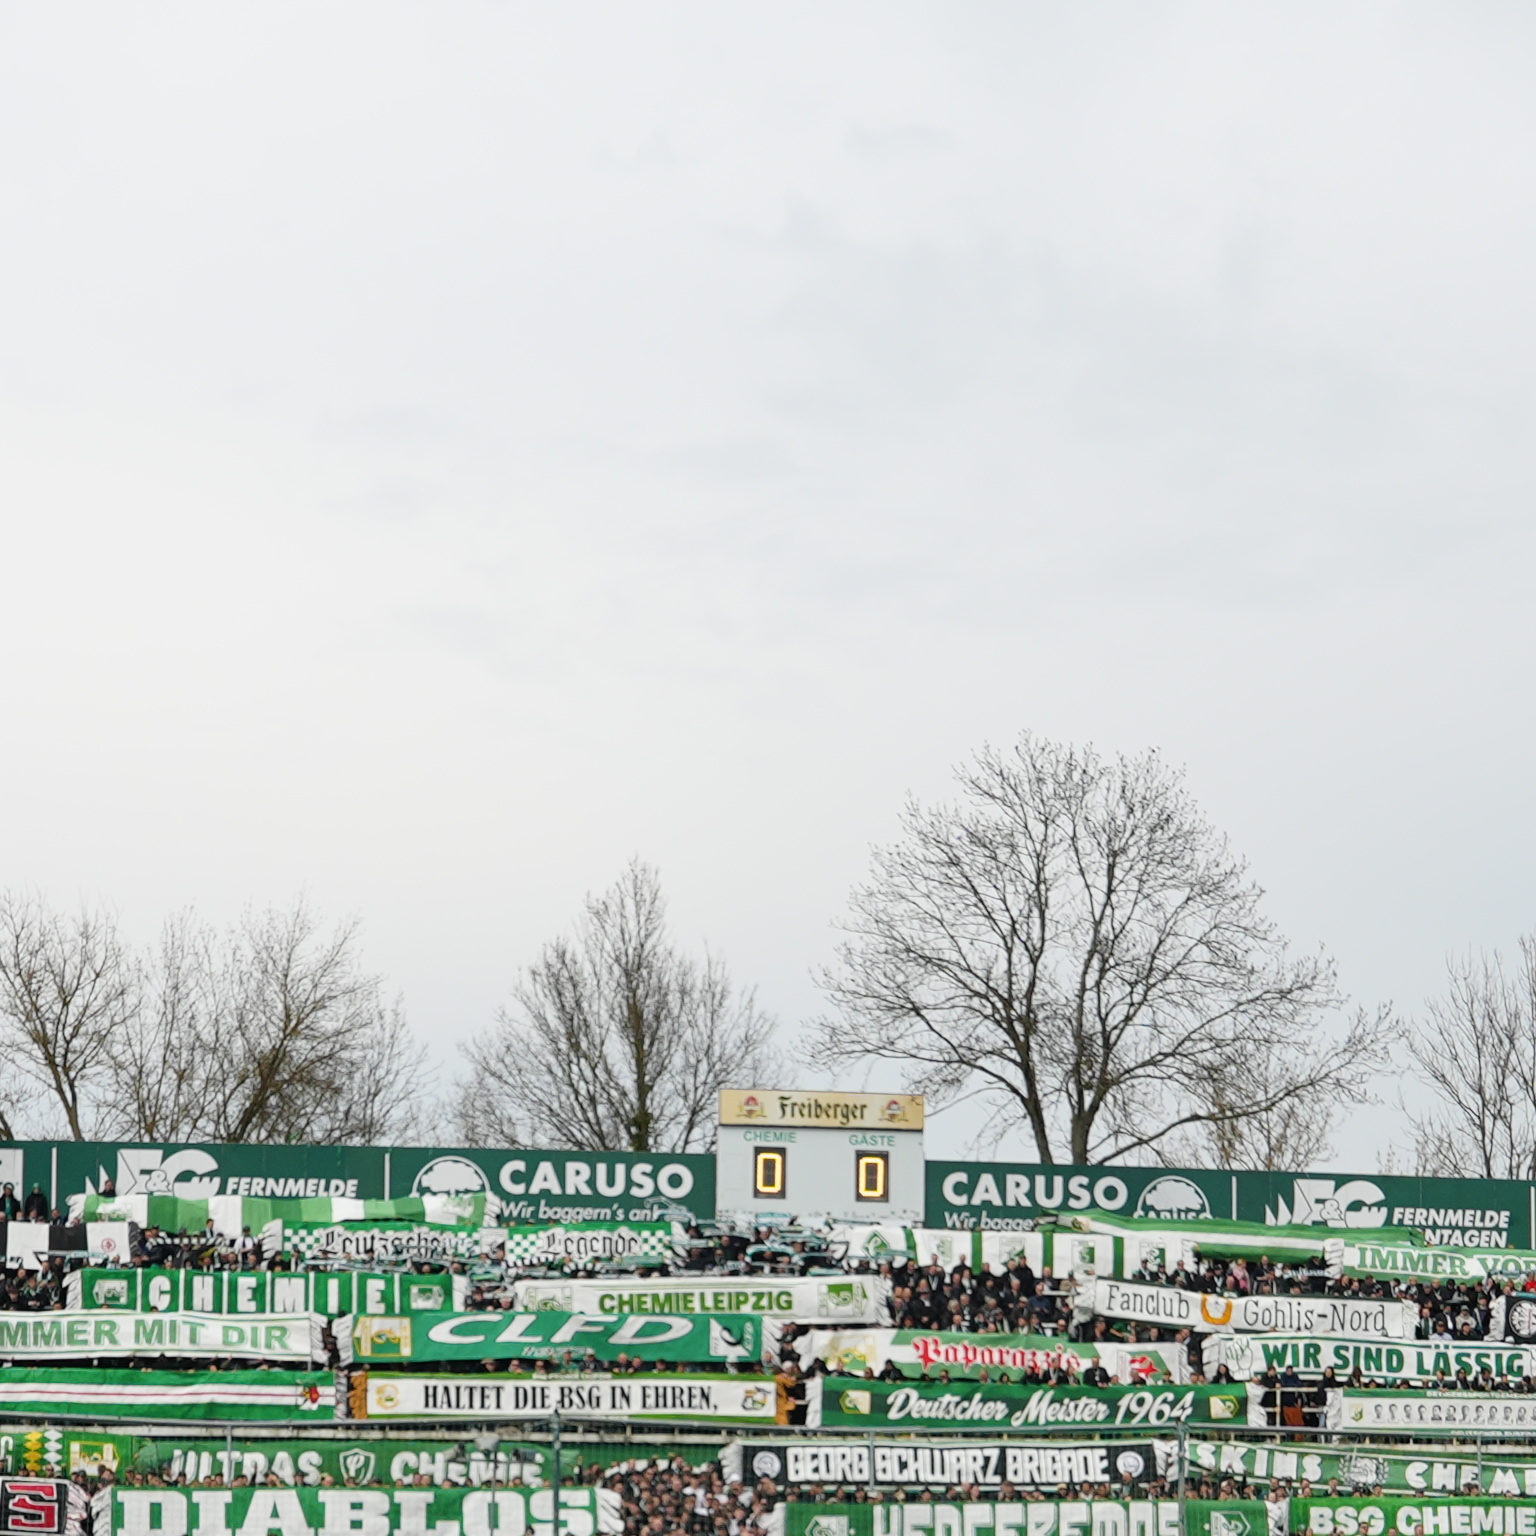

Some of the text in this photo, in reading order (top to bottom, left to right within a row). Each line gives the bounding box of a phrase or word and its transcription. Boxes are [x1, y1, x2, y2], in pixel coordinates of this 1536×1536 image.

[778, 1095, 868, 1125] Freiberger
[743, 1130, 896, 1146] CHEMIE GÄSTE
[225, 1177, 359, 1199] FERNMELDE
[499, 1160, 694, 1199] CARUSO
[756, 1152, 885, 1197] 0 0
[942, 1170, 1129, 1210] CARUSO
[501, 1198, 624, 1224] Wir baggern's
[944, 1211, 978, 1230] Wir
[1393, 1207, 1511, 1229] FERNMELDE
[1425, 1228, 1509, 1249] NTAGEN
[1357, 1246, 1470, 1278] IMMER
[149, 1274, 386, 1314] CHEMIE
[599, 1291, 793, 1314] CHEMIE LEIPZIG
[1106, 1285, 1387, 1337] Fanclub Gohlis-Nord
[135, 1318, 209, 1346] MIT
[222, 1324, 292, 1350] DIR
[426, 1314, 694, 1345] CLFD
[1265, 1341, 1525, 1378] WIR SIND LÄSSIG
[424, 1384, 719, 1413] HALTET DIE BSG IN EHREN,
[887, 1388, 1195, 1427] Deutscher Meister 1964
[170, 1448, 324, 1487] ULTRAS
[786, 1446, 1109, 1484] GEORG SCHWARZ BRIGADE
[1196, 1442, 1322, 1482] SKINS
[1309, 1505, 1385, 1536] BSG
[1396, 1505, 1536, 1536] CHEMIE
